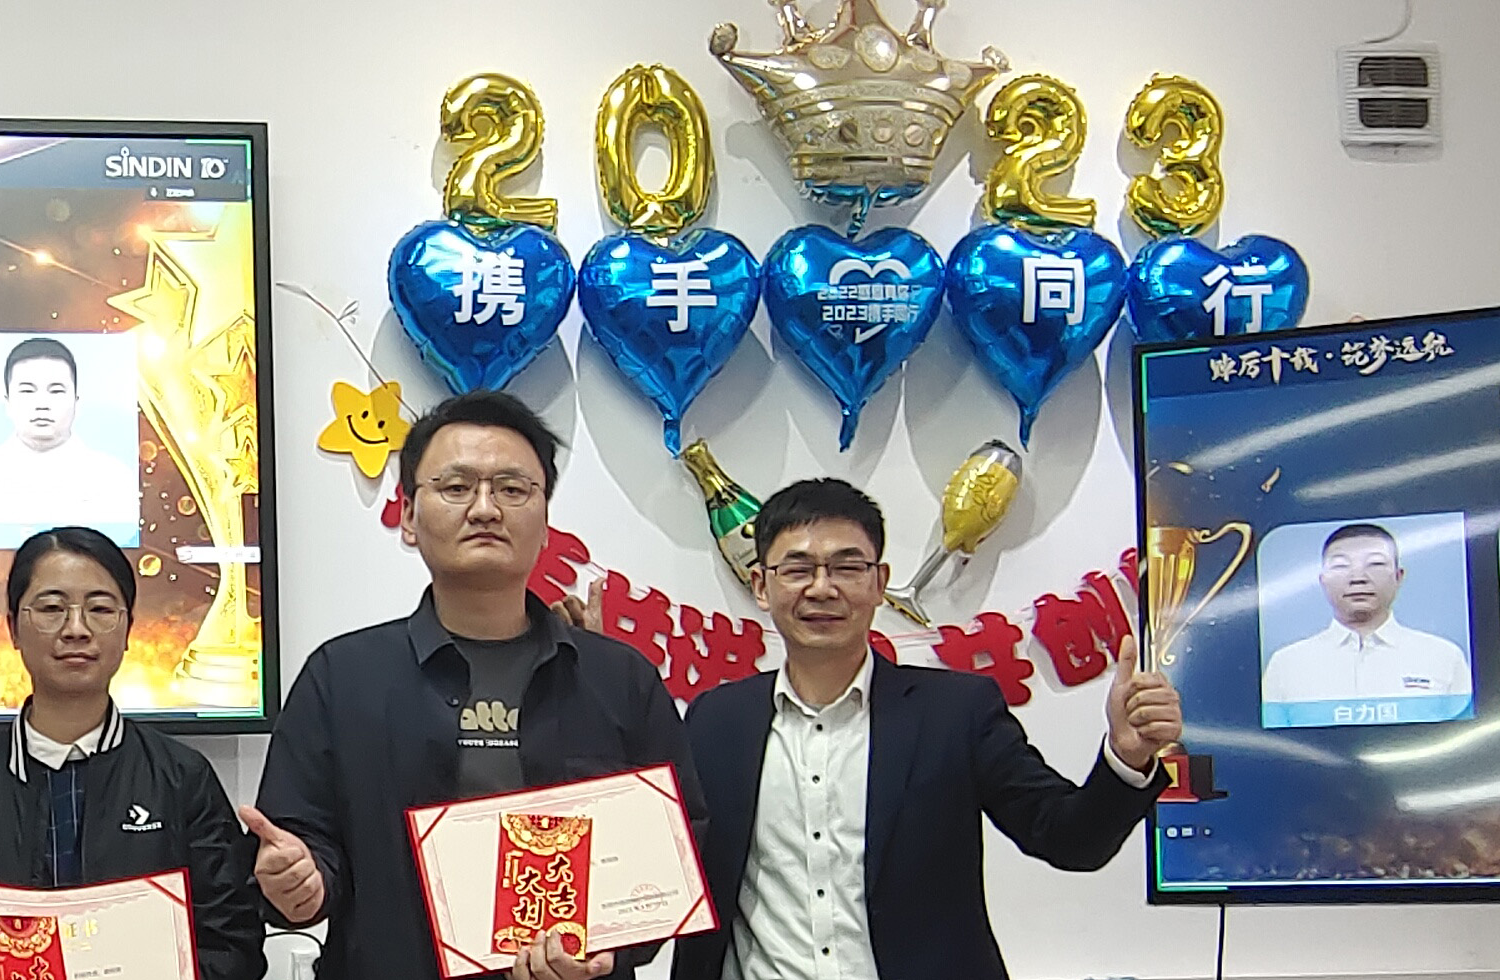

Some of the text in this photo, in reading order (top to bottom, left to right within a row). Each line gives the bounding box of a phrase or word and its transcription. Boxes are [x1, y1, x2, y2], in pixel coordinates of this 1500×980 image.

[441, 73, 558, 233] 2
[981, 76, 1096, 228] 2
[1127, 73, 1223, 237] 3
[452, 253, 1273, 336] 携 手 同 行
